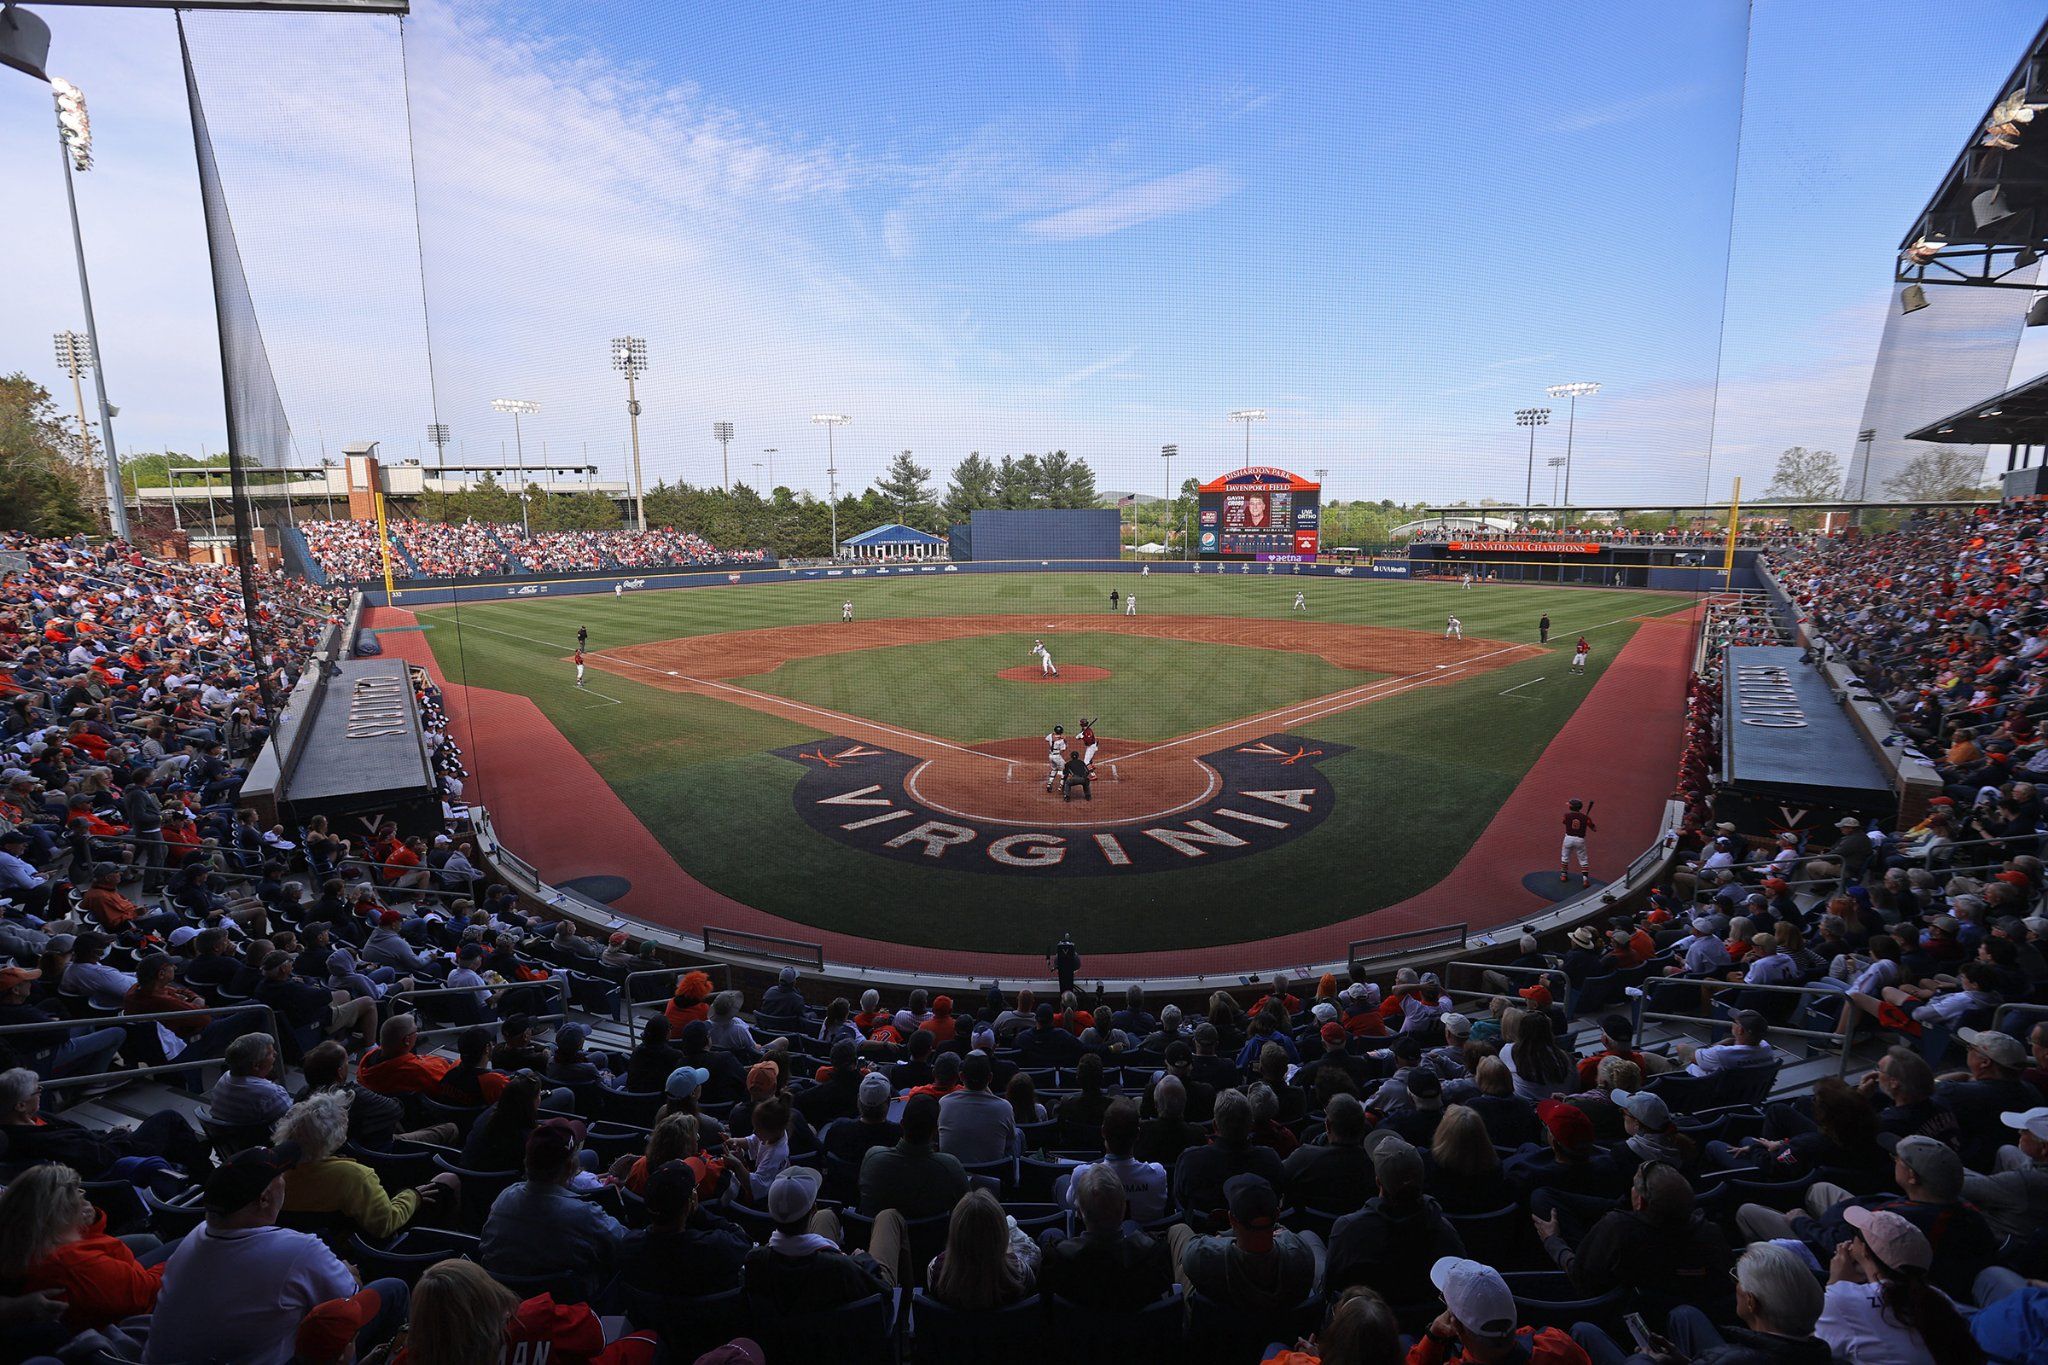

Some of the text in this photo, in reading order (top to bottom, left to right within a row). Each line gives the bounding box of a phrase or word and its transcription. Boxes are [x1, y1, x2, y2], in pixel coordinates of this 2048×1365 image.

[1225, 467, 1291, 480] DISHAROON PARK
[1460, 542, 1585, 552] 2015 NATIONAL CHAMPIONS
[1276, 553, 1302, 561] aetna
[816, 783, 1317, 867] VIRGINIA
